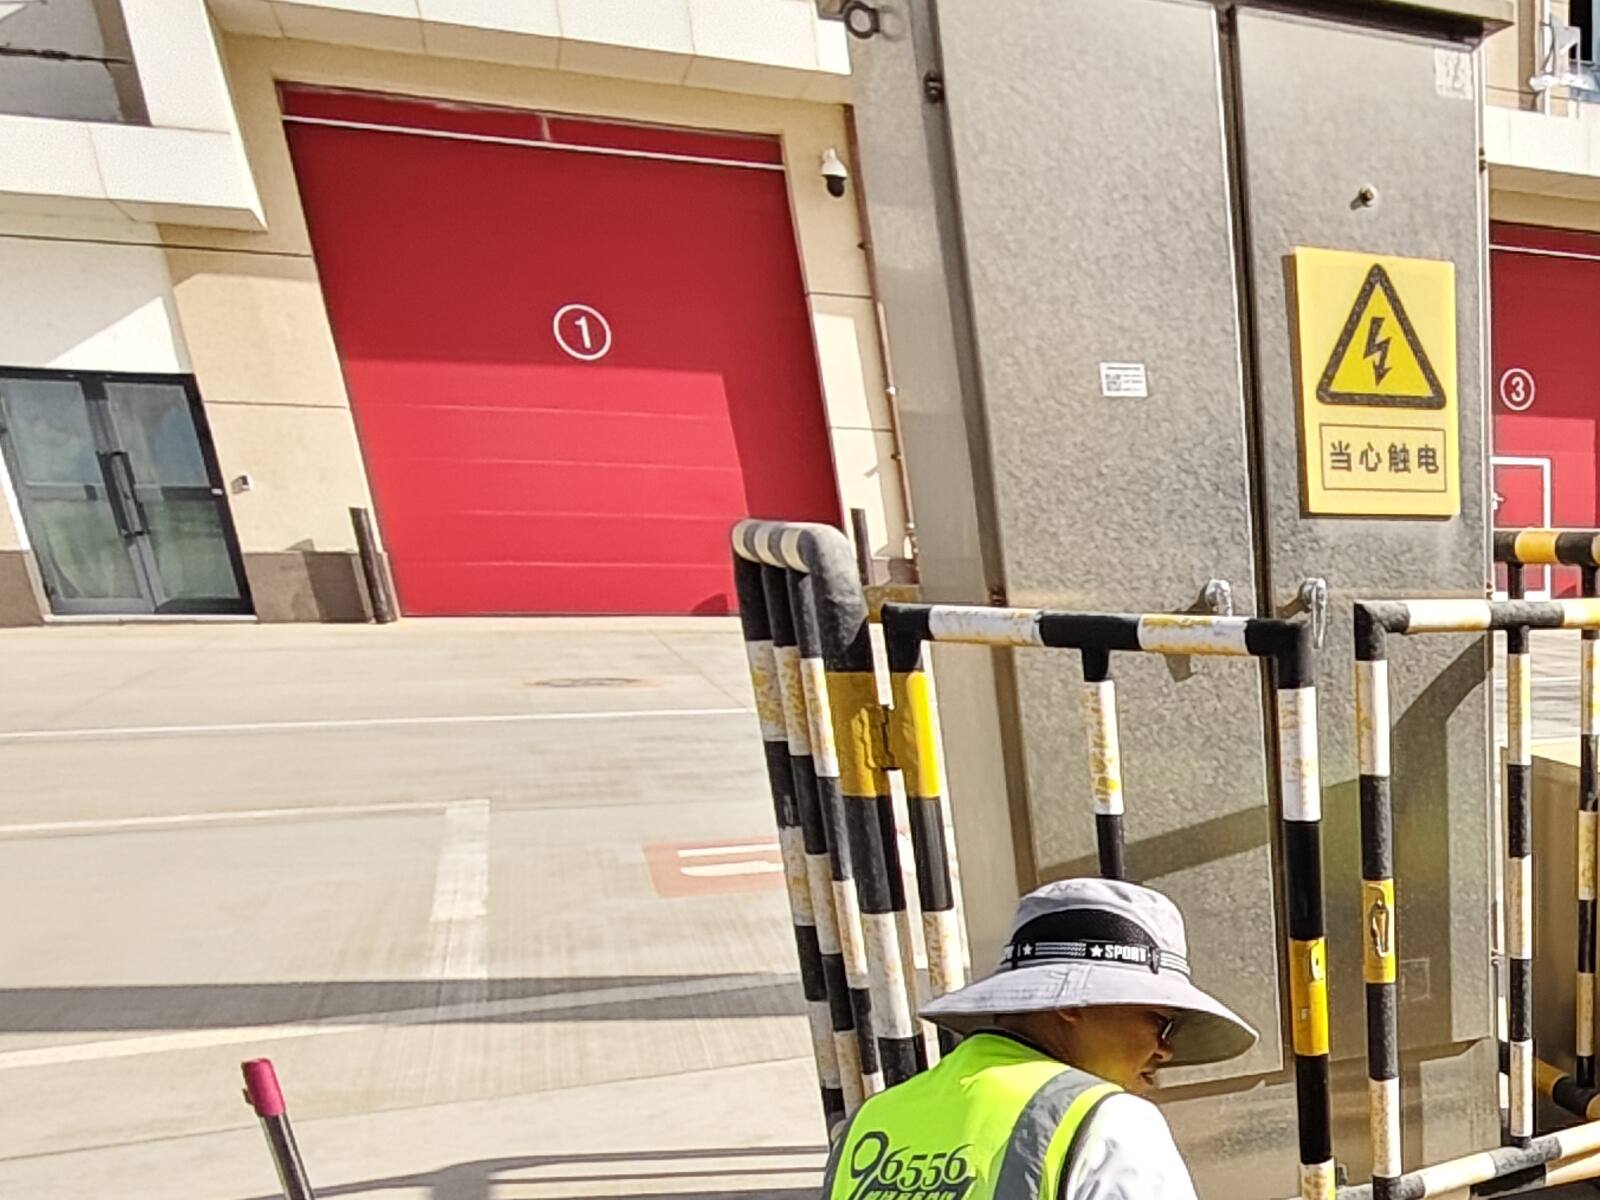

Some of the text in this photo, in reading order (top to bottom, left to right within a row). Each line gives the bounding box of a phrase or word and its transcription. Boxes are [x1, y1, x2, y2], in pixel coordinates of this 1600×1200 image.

[1330, 440, 1439, 474] 当心触电
[1105, 944, 1147, 962] SPORT
